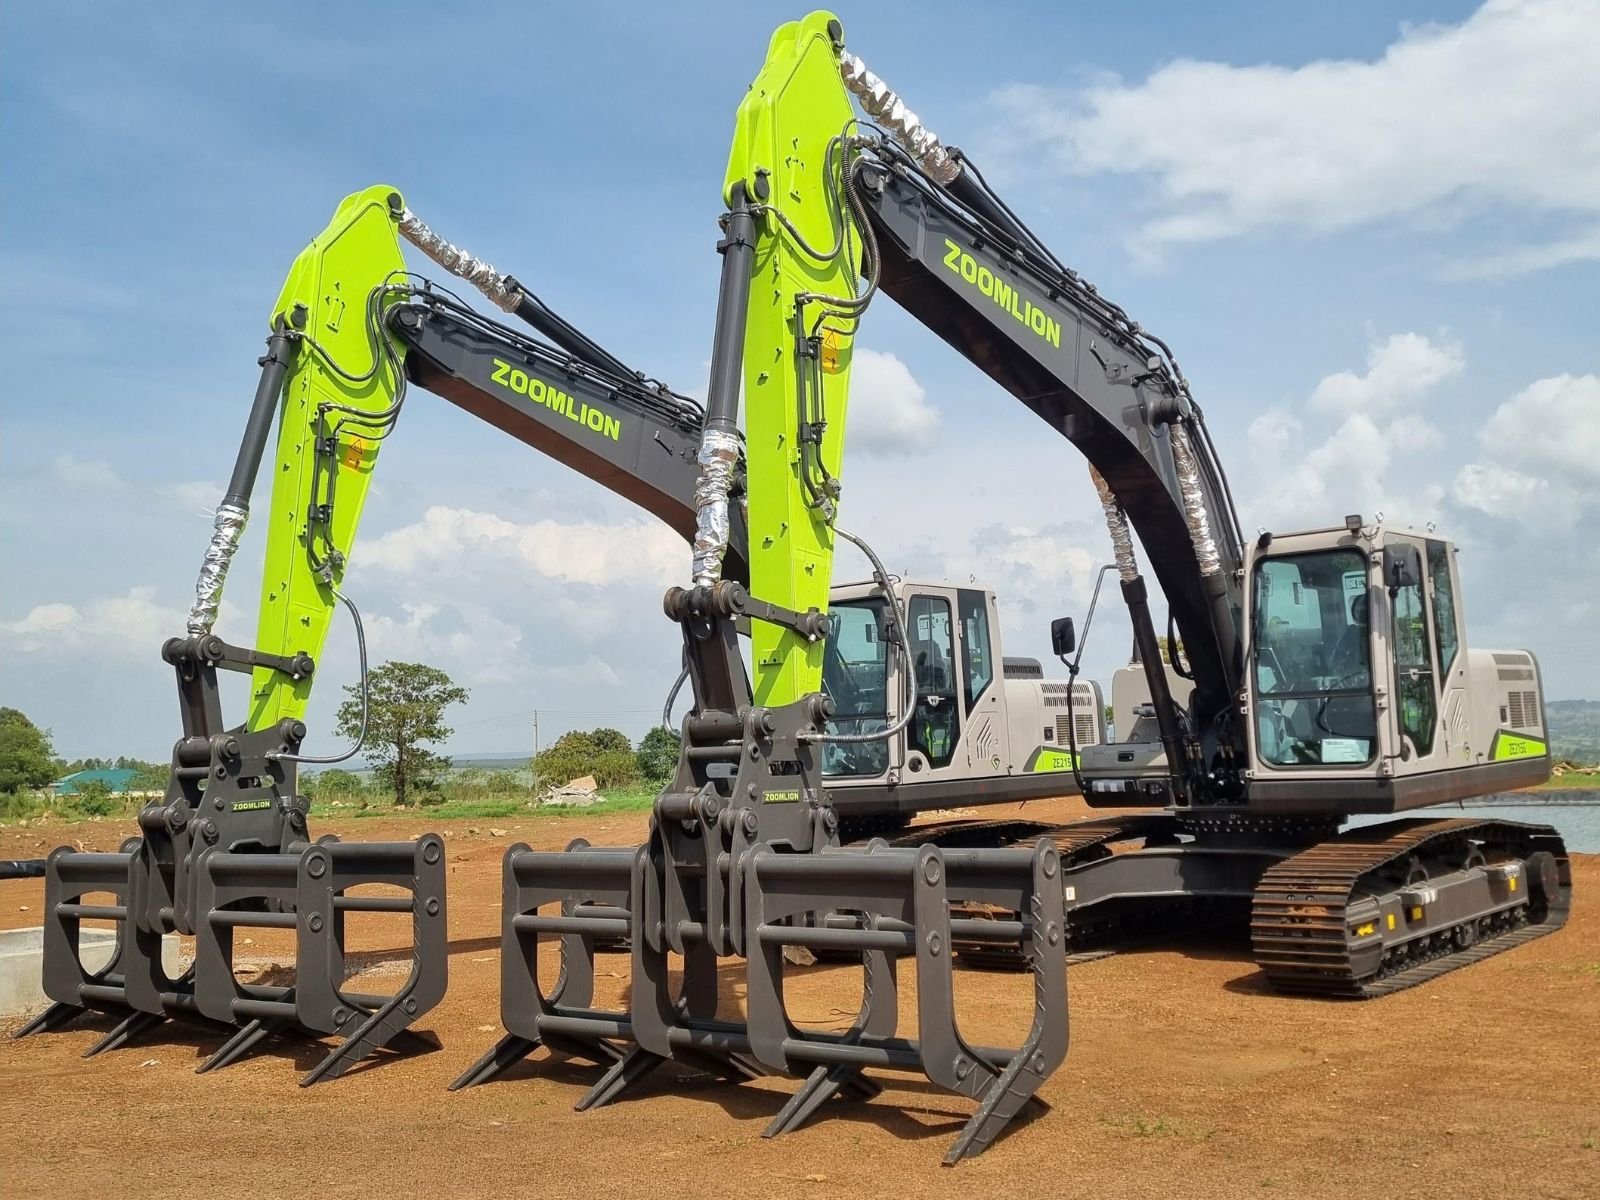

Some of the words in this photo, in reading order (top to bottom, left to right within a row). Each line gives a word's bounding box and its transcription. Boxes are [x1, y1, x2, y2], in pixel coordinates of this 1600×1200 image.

[944, 238, 1060, 349] ZOOMLION
[491, 358, 620, 441] ZOOMLION
[1053, 757, 1072, 768] ZE215
[765, 792, 799, 801] ZOOMLION
[232, 800, 270, 810] ZOOMLION
